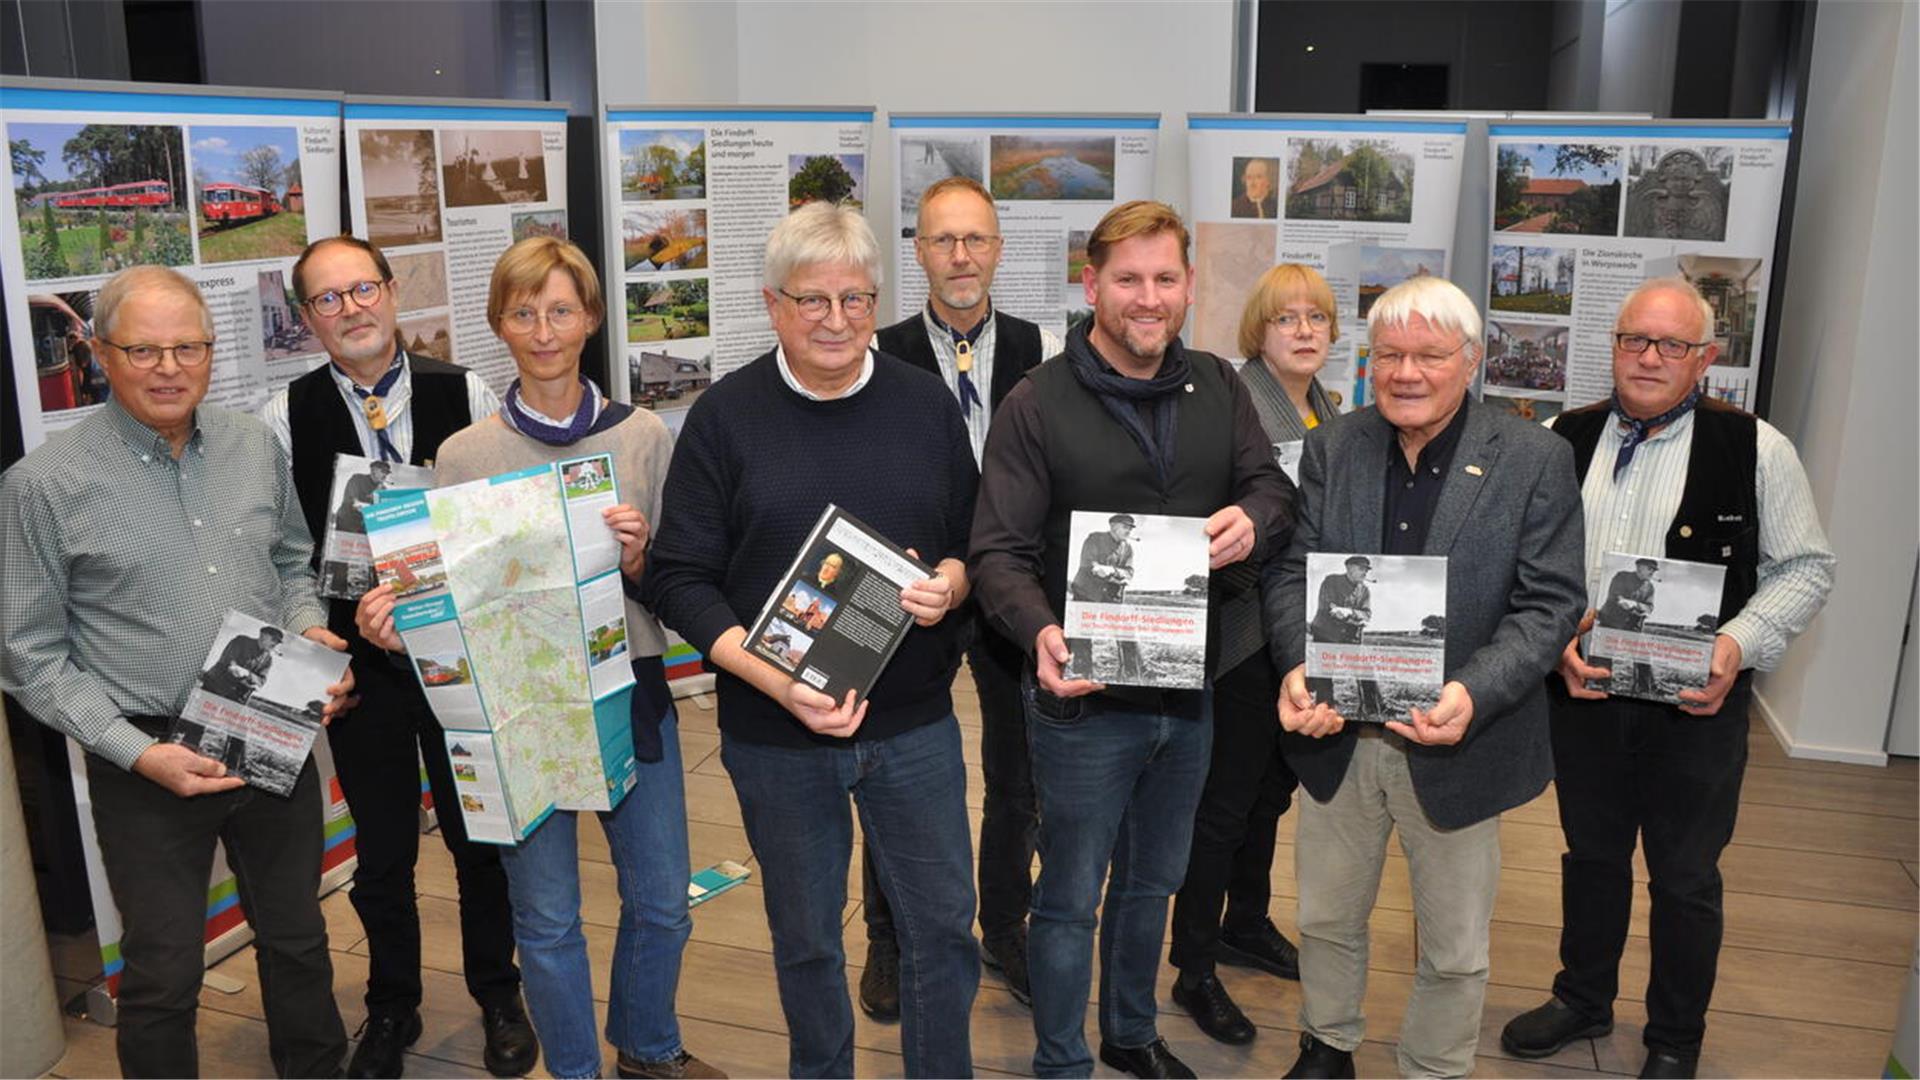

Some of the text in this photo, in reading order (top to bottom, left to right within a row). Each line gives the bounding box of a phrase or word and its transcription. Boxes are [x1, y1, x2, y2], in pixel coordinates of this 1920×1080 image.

[710, 128, 723, 137] Die
[711, 139, 774, 149] Siedlungen heute
[711, 150, 756, 160] und morgen
[1582, 248, 1644, 259] Die Zionskirche
[1581, 259, 1638, 270] in Worpswede
[1081, 611, 1097, 621] Die
[1099, 611, 1196, 627] Findorff-Siedlungen
[1321, 651, 1434, 665] Die Findorff-Siedlungen
